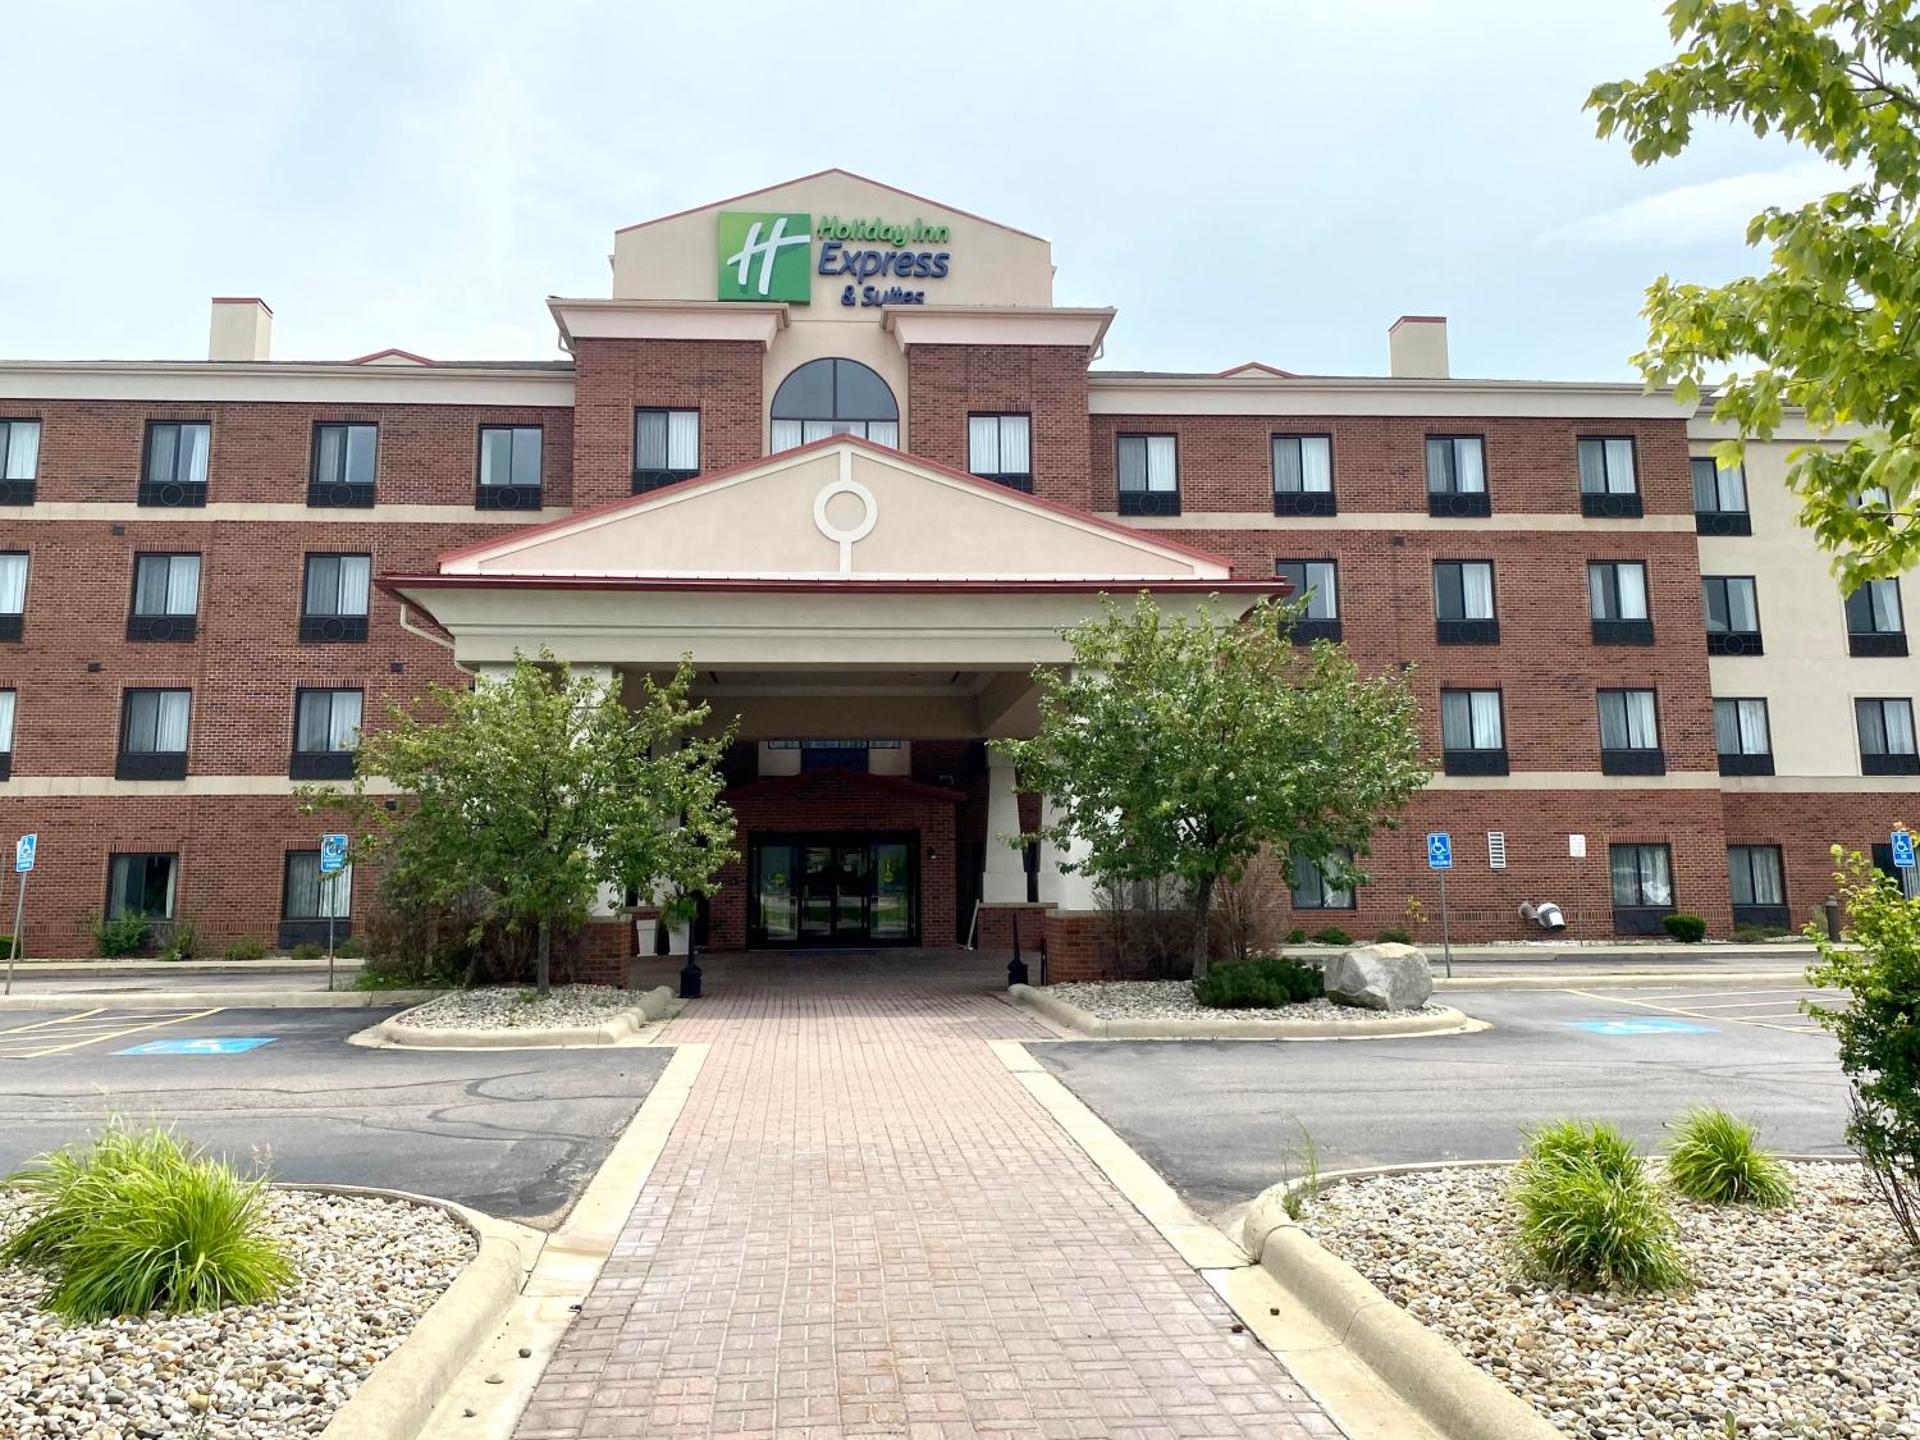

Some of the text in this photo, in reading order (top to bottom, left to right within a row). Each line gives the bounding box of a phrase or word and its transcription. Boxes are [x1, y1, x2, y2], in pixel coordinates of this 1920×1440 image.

[817, 216, 950, 247] Holiday Inn
[818, 242, 950, 284] Express
[841, 285, 925, 306] & Suites
